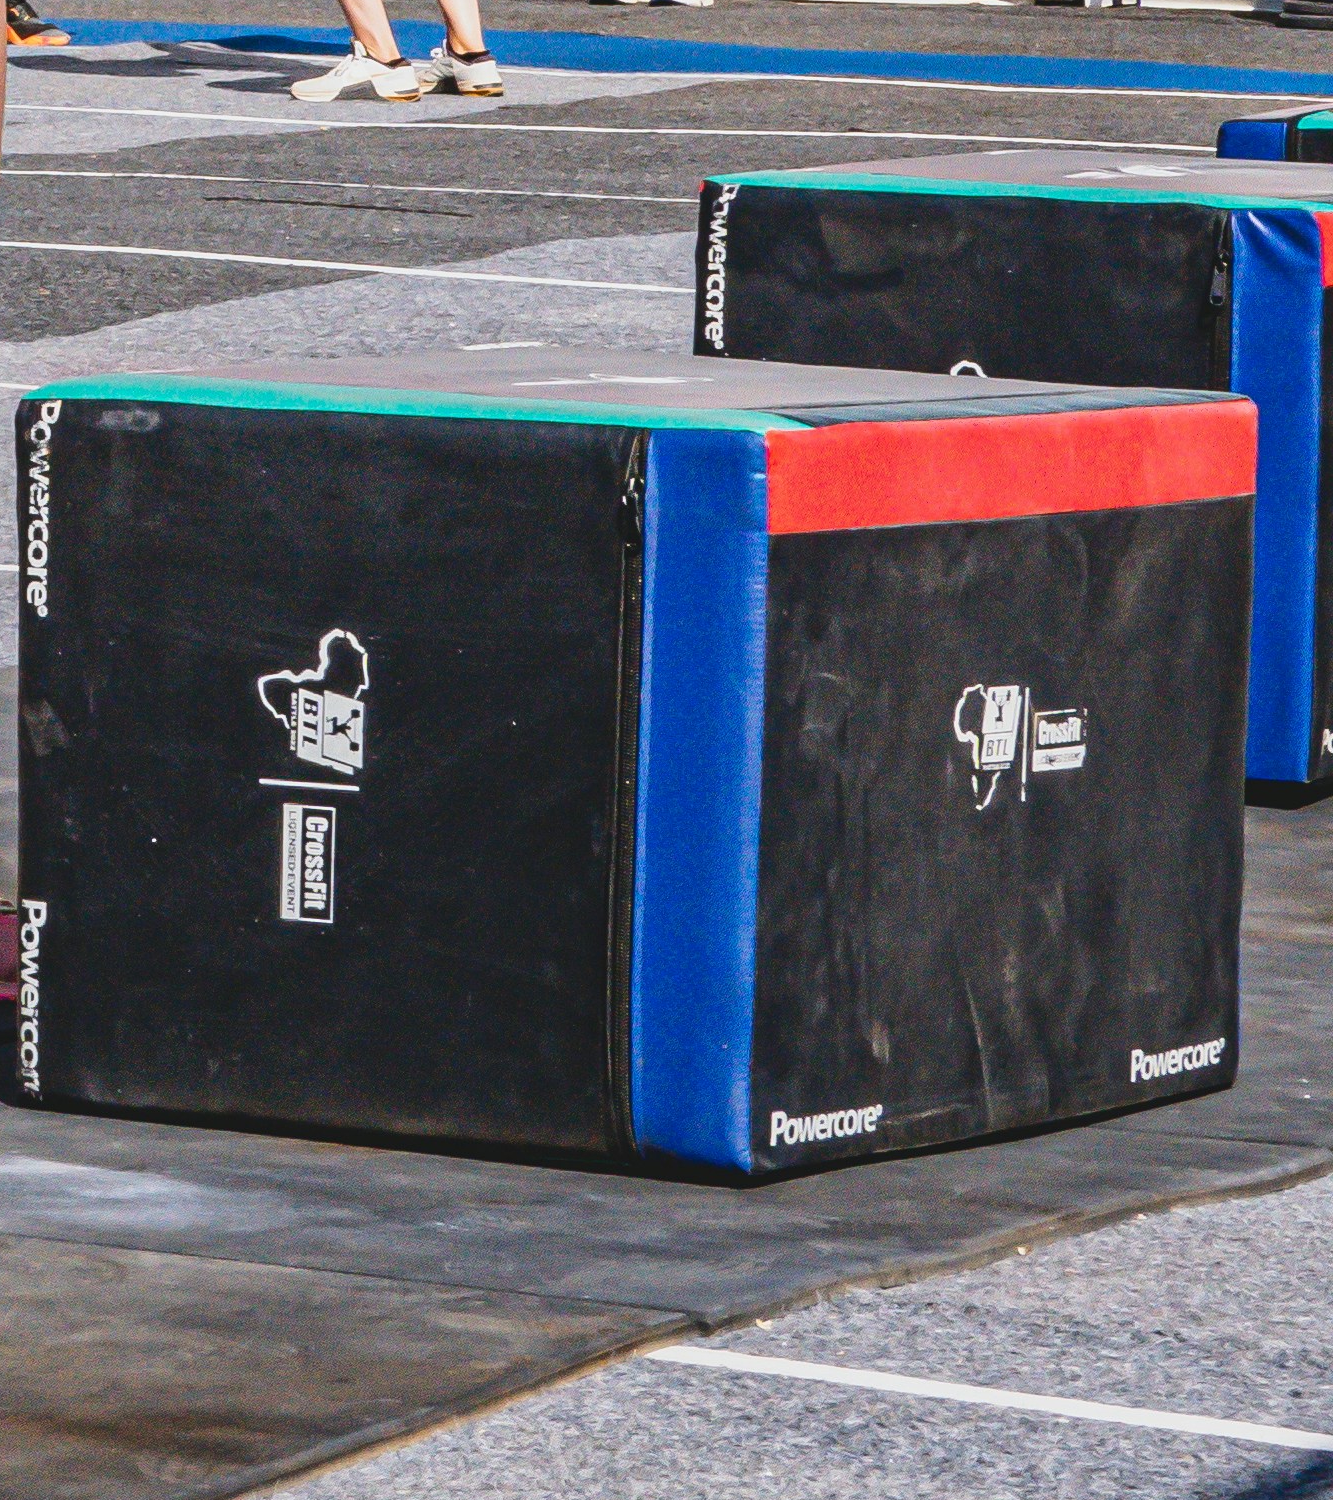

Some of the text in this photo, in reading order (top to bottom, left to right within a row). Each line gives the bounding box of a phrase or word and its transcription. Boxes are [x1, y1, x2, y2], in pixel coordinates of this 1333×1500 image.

[302, 697, 320, 749] BTL
[985, 737, 1010, 758] BTL
[303, 815, 330, 912] CrossFit
[1129, 1040, 1224, 1083] Powercore
[769, 1108, 877, 1147] Powercore
